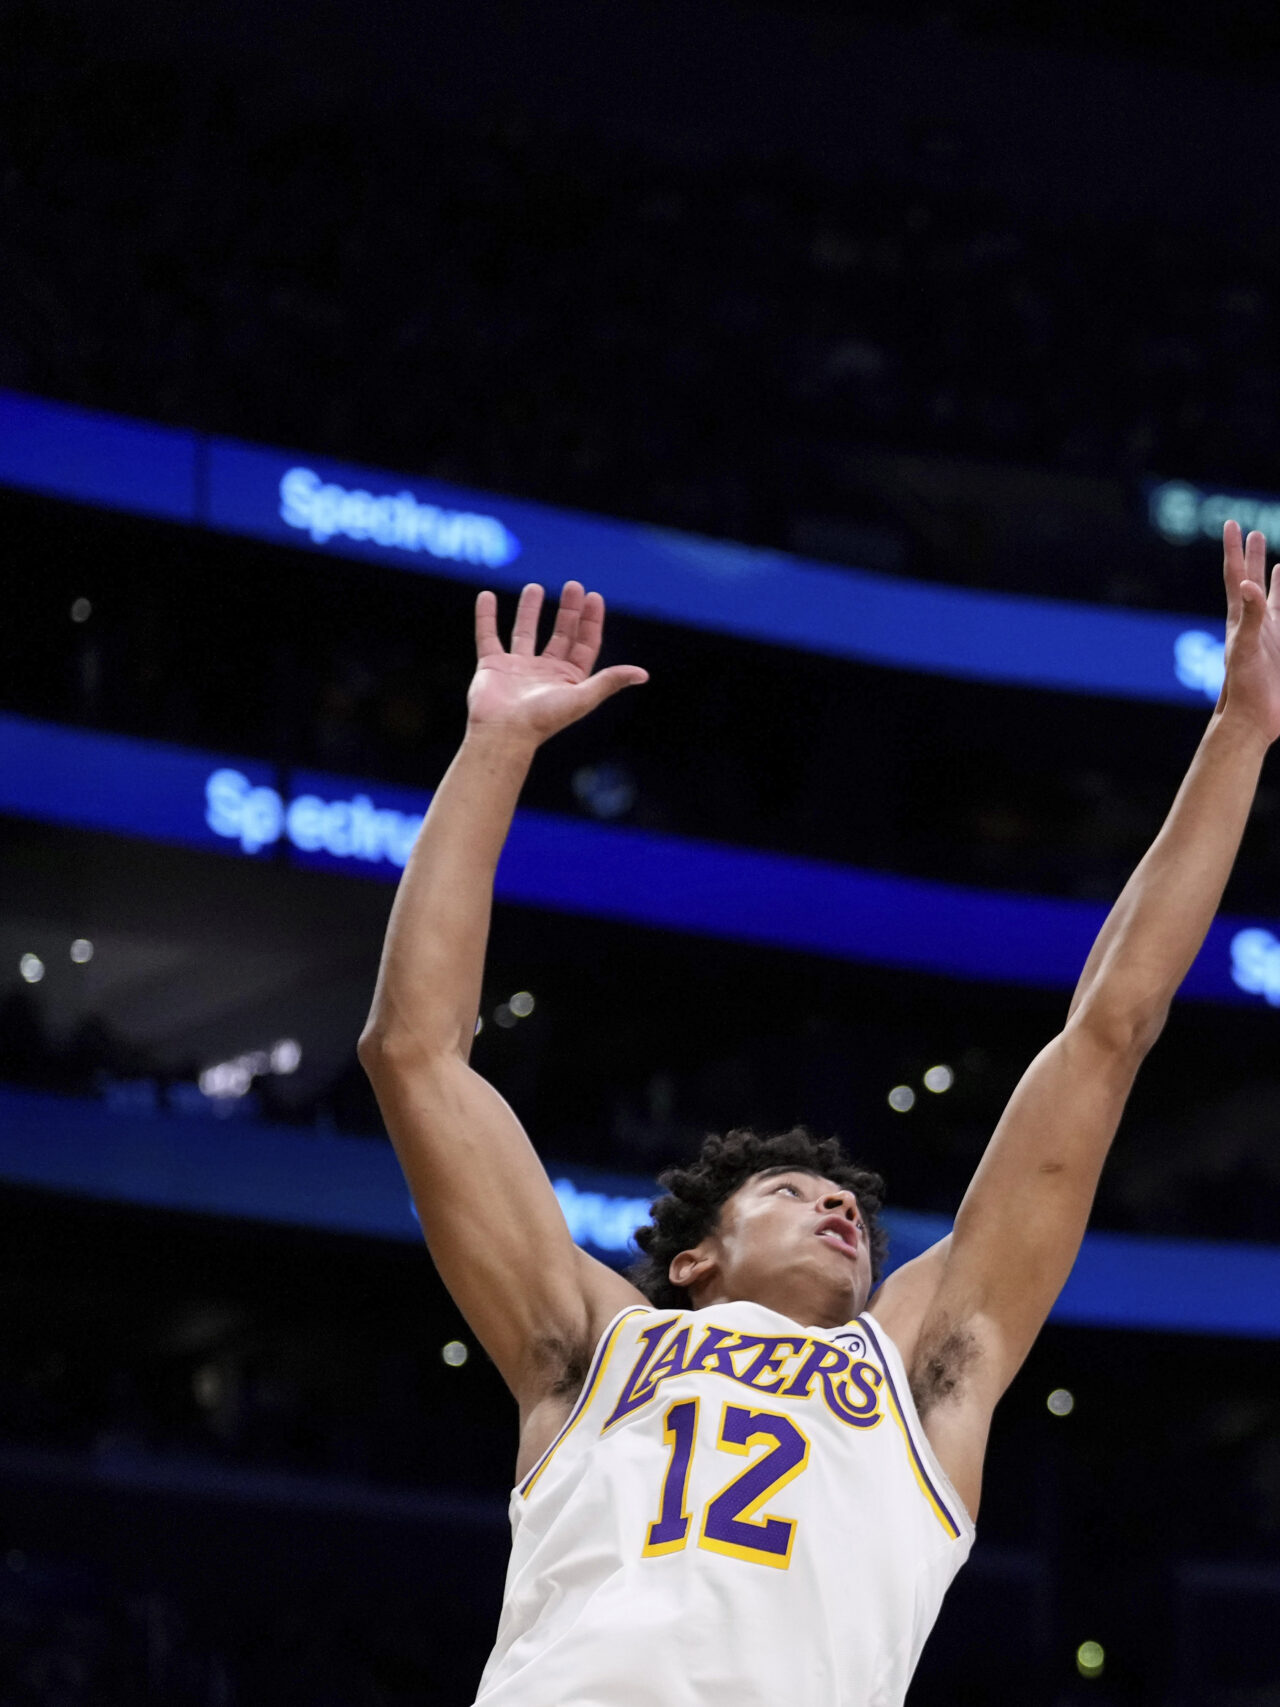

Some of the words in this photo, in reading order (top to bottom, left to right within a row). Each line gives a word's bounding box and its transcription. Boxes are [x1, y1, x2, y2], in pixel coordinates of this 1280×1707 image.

[280, 467, 510, 568] Spectrum
[600, 1314, 884, 1435] LAKERS
[641, 1396, 811, 1569] 12
